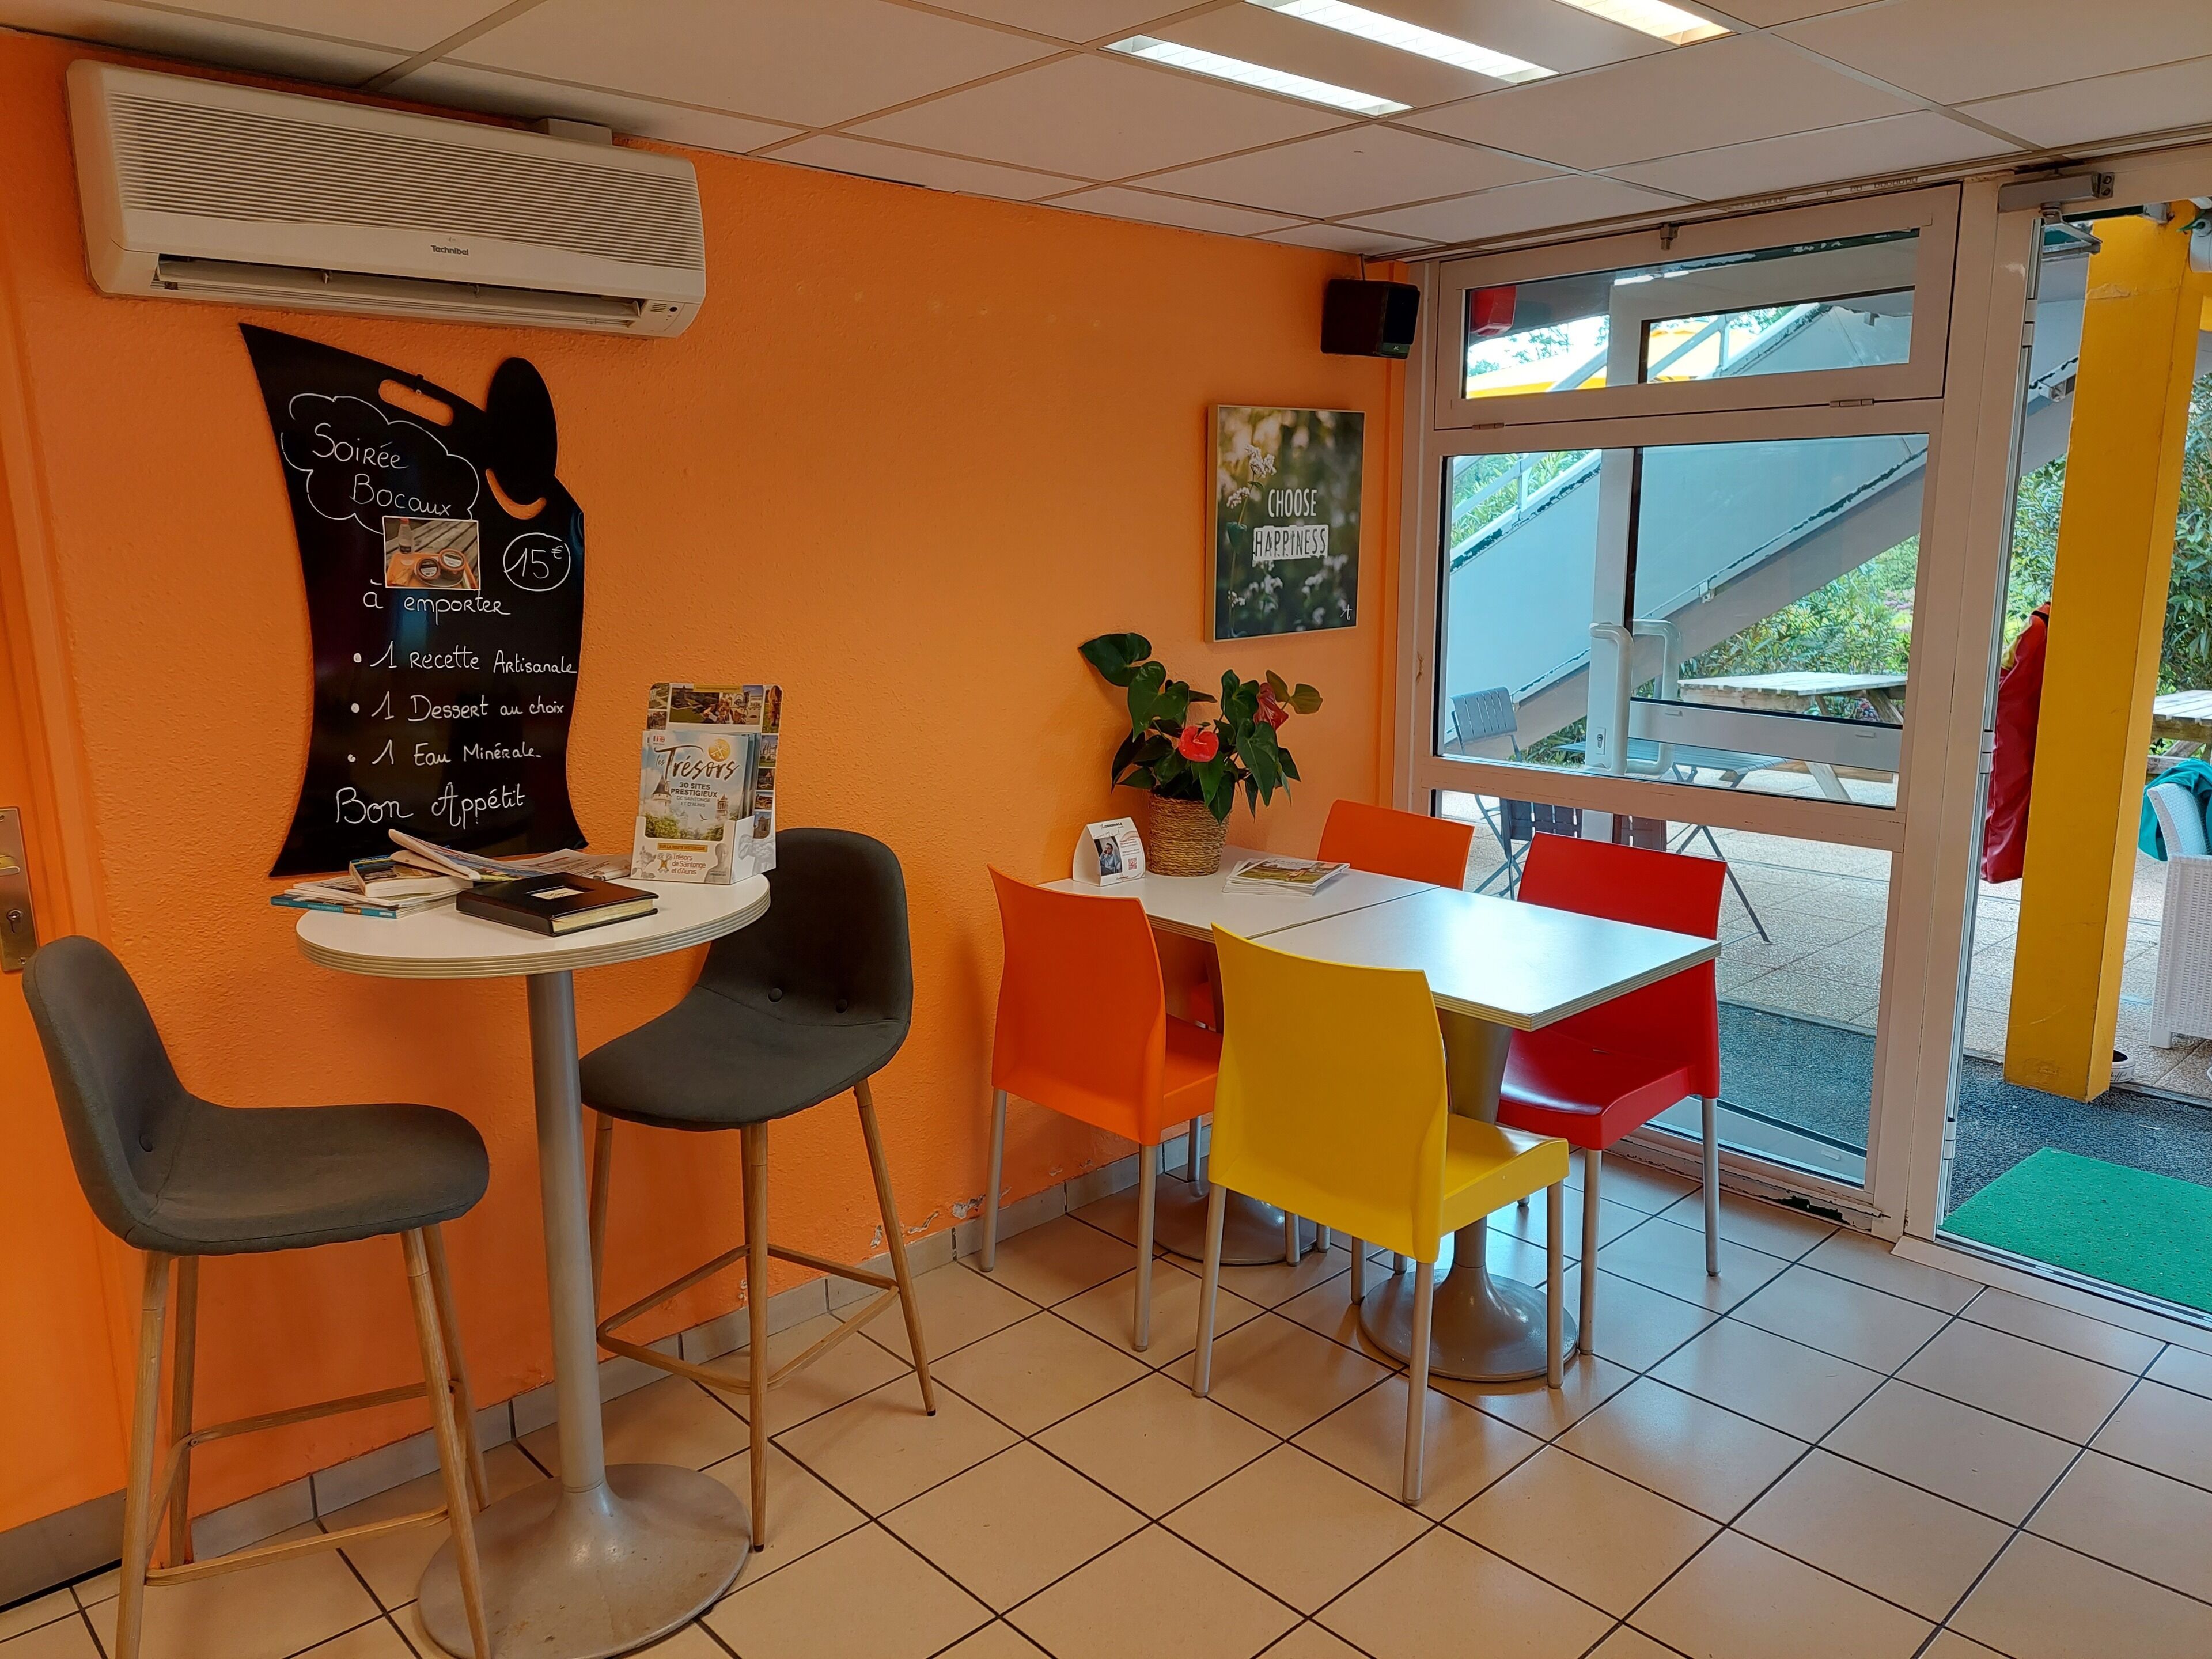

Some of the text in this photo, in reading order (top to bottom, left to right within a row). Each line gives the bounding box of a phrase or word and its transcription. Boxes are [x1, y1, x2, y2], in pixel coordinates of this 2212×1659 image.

[430, 245, 469, 255] Technibel
[313, 423, 407, 469] Soirée
[350, 474, 452, 516] Bocaux
[1268, 488, 1317, 517] CHOOSE
[1255, 528, 1326, 557] HAPPINESS
[363, 579, 511, 625] à emporter
[493, 650, 578, 673] Artisanale
[408, 695, 489, 721] Dessert
[501, 705, 523, 716] au
[529, 695, 564, 714] choix
[414, 743, 451, 766] Eau
[463, 741, 541, 762] Minérale
[654, 745, 740, 781] Trésors
[336, 782, 526, 830] Bon Appétit
[671, 788, 718, 798] PRESTIGIEUX
[672, 853, 693, 861] Trésors
[680, 861, 707, 870] Saintonge
